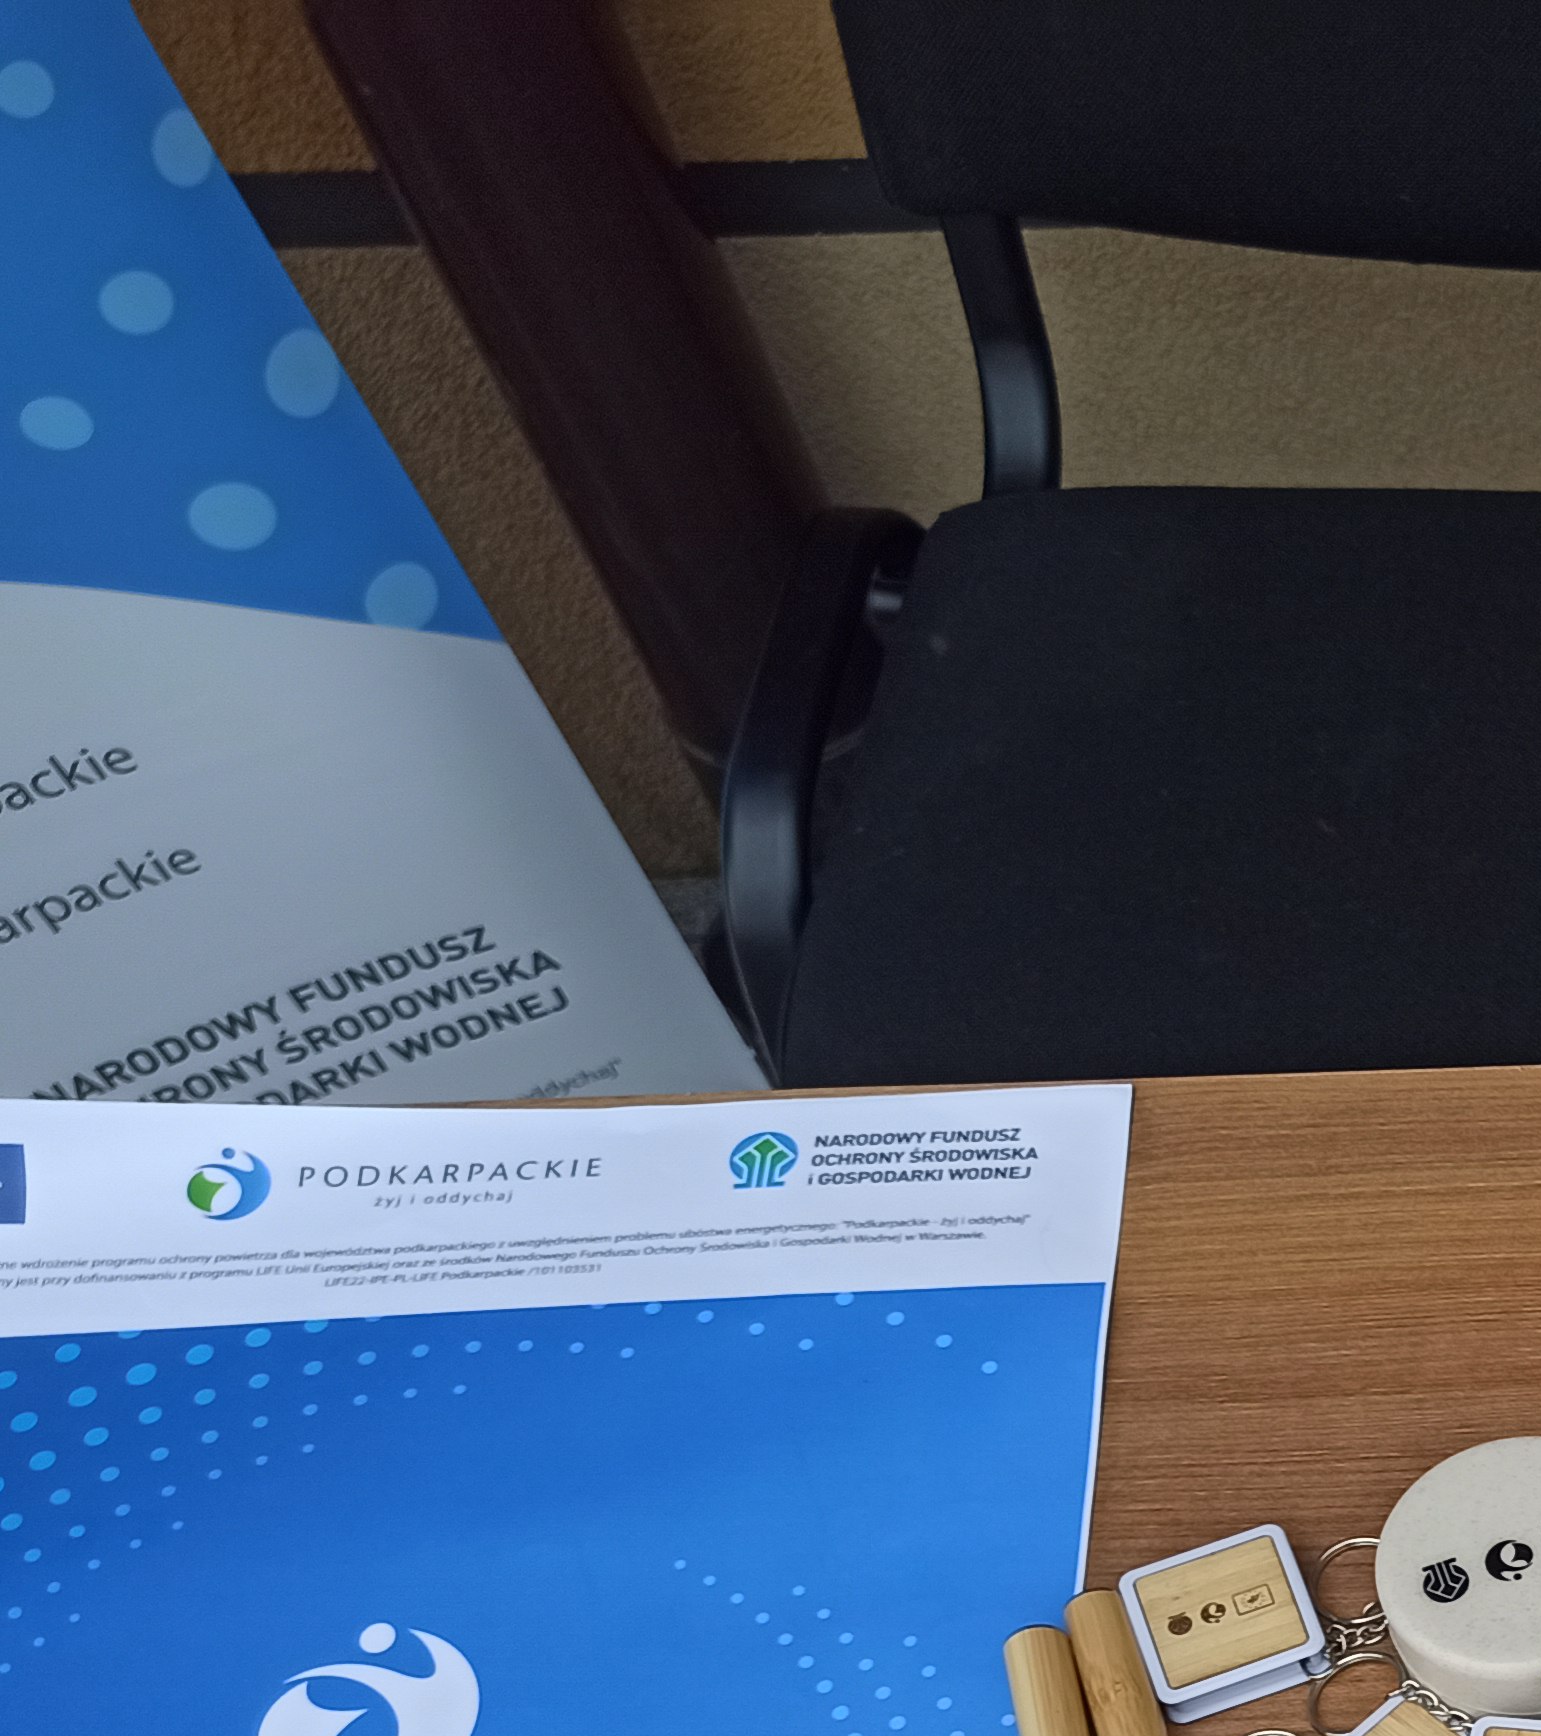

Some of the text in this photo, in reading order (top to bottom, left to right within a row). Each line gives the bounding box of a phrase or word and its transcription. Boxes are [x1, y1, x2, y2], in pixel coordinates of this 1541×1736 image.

[0, 747, 138, 815] ackie
[289, 923, 497, 1014] FUNDUSZ
[276, 948, 562, 1064] ŚRODOWISKA
[389, 986, 571, 1063] WODNEJ
[814, 1127, 1021, 1147] NARODOWY FUNDUSZ
[811, 1147, 1038, 1166] OCHRONY ŚRODOWISKA
[298, 1157, 600, 1187] PODKARPACKIE
[807, 1166, 1031, 1185] i GOSPODARKI WODNEJ
[373, 1190, 512, 1208] żyj i oddychaj
